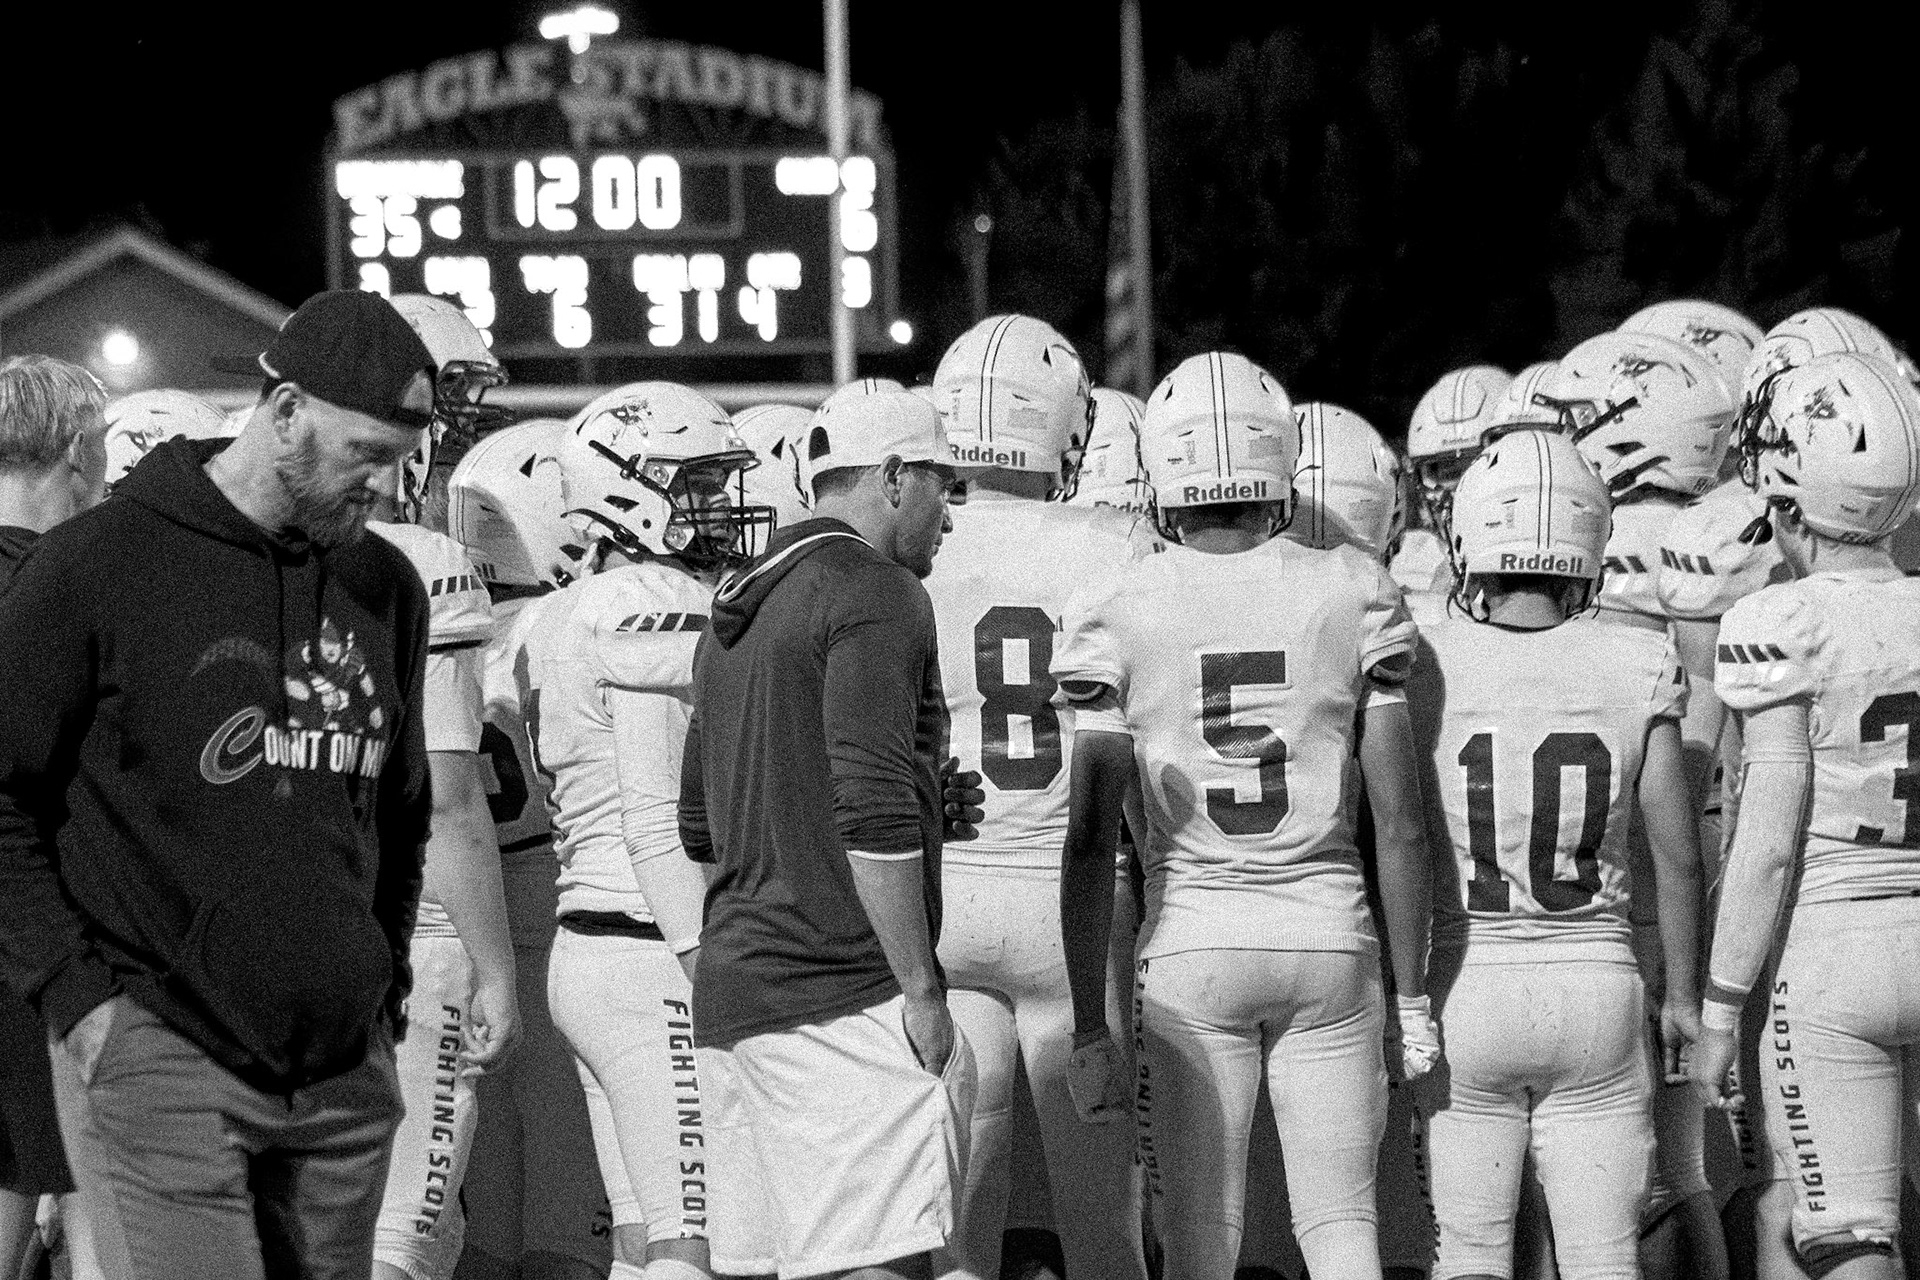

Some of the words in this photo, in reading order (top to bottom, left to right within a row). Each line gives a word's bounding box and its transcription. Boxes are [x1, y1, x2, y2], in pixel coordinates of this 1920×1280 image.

[333, 43, 555, 150] EAGLE
[350, 195, 422, 257] 35
[950, 443, 1026, 468] Riddell
[1183, 481, 1267, 503] Riddell
[1501, 553, 1583, 574] Riddell
[974, 606, 1063, 791] 8
[1200, 650, 1290, 836] 5
[1458, 732, 1612, 912] 10
[1859, 690, 1920, 850] 3
[432, 1004, 461, 1144] FIGHTING
[663, 999, 705, 1148] FIGHTING
[1773, 980, 1796, 1071] SCOTS
[415, 1152, 451, 1236] SCOTS
[1780, 1084, 1827, 1213] FIGHTING
